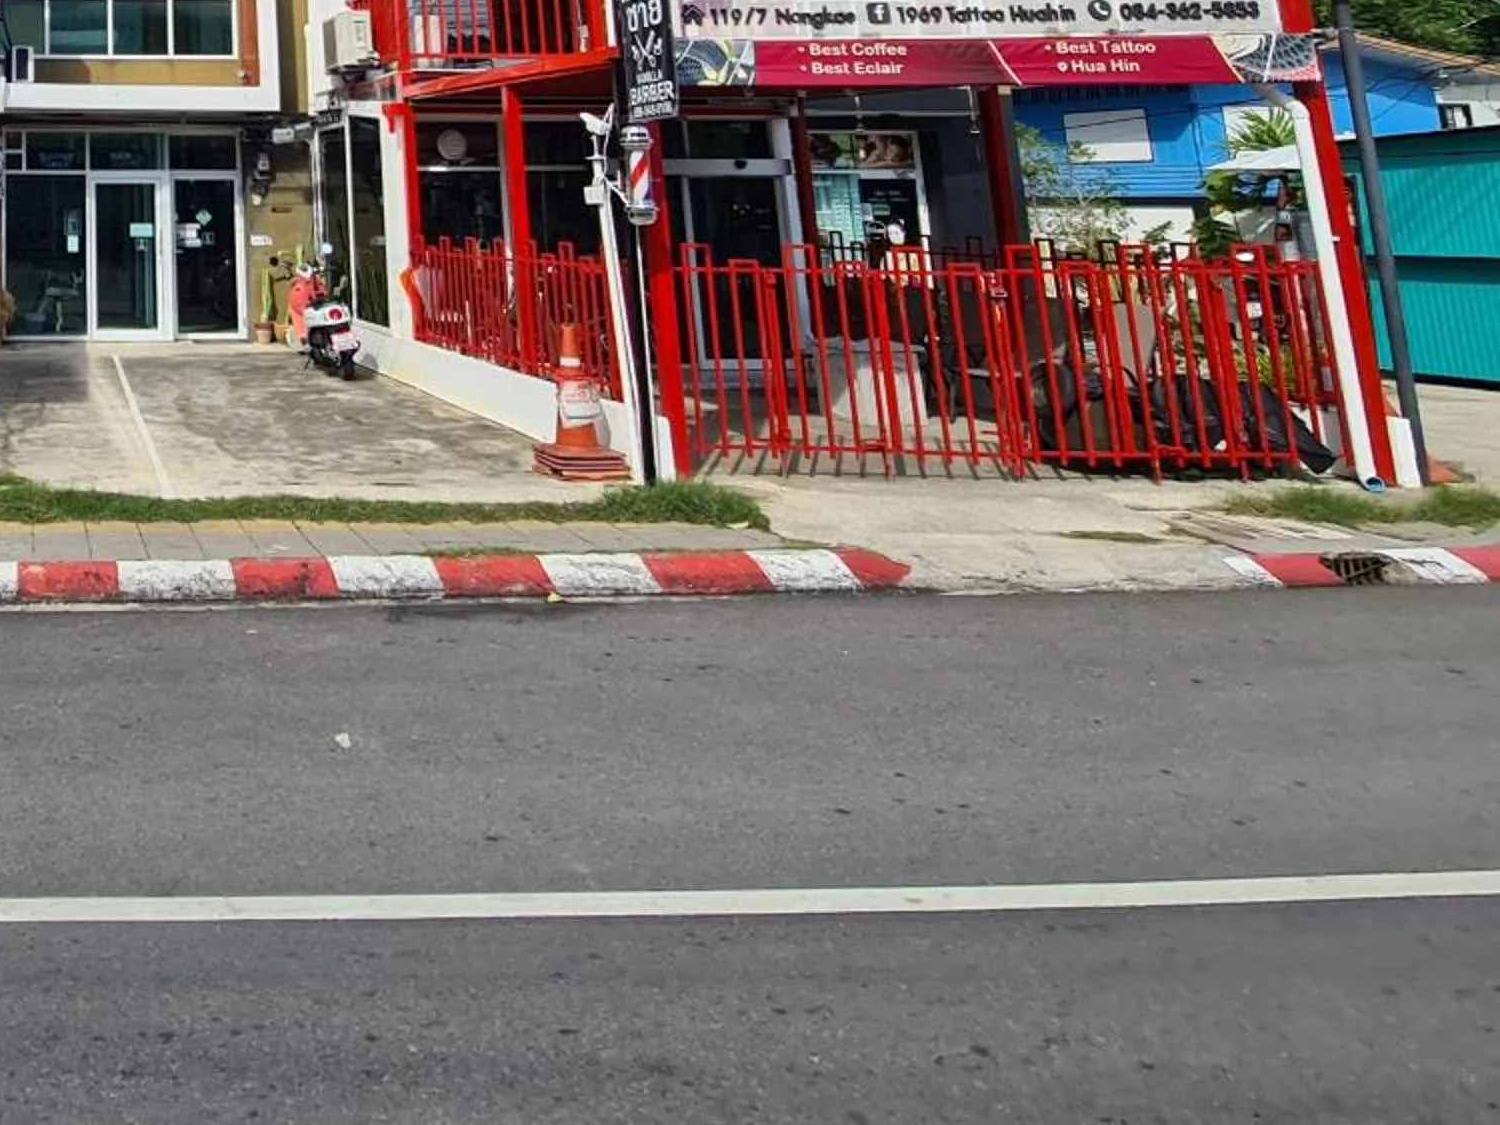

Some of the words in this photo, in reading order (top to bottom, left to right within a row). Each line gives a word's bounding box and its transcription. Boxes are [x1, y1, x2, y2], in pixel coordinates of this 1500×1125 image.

[710, 7, 767, 26] 119/7
[896, 6, 942, 24] 1969
[946, 6, 1005, 24] Tattoo
[1009, 3, 1076, 23] Huahin
[809, 43, 849, 56] Best
[851, 42, 907, 56] Coffee
[1055, 41, 1097, 54] Best
[1100, 40, 1156, 54] Tattoo
[811, 62, 850, 75] Best
[853, 61, 903, 75] Eclair
[1071, 58, 1109, 72] Hua
[1114, 58, 1140, 72] Hin
[630, 80, 675, 106] BARBER
